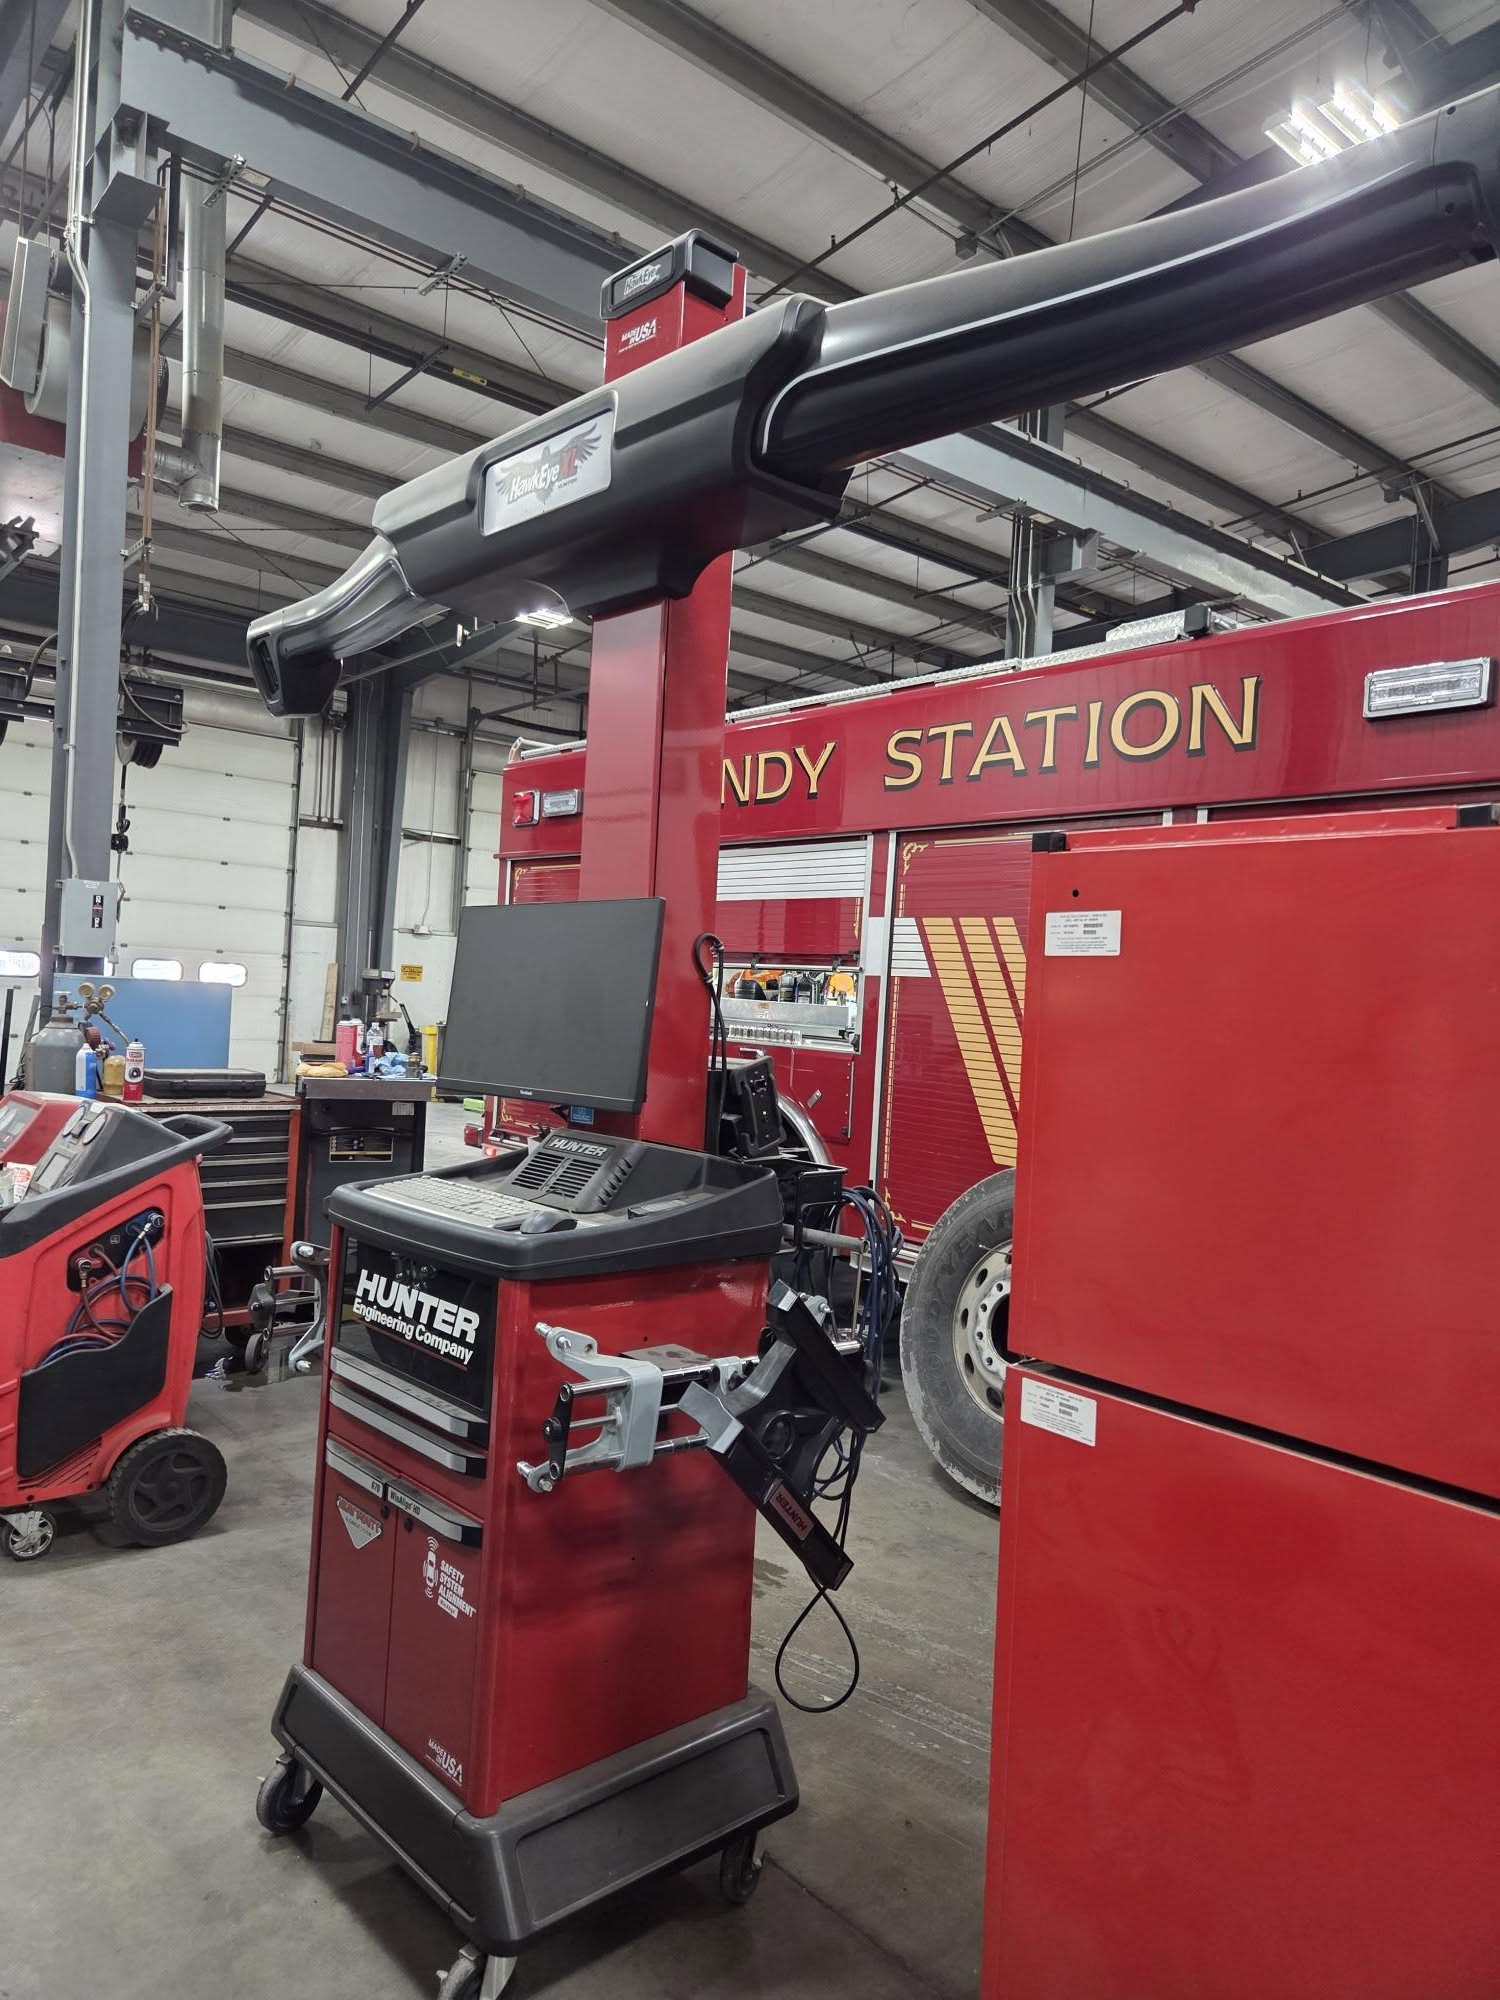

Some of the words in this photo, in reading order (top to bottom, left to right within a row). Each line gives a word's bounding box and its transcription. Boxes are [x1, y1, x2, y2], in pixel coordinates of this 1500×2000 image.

[635, 319, 656, 342] USA
[509, 464, 560, 501] HawkEye
[884, 674, 1262, 791] STATION
[549, 1138, 608, 1157] HUNTER
[356, 1269, 480, 1344] HUNTER
[353, 1298, 414, 1340] Engineering
[415, 1325, 473, 1365] Company
[371, 1481, 381, 1493] 670
[776, 1493, 808, 1531] HUNTER
[440, 1560, 465, 1584] SAFETY
[440, 1572, 464, 1598] SYSTEM
[438, 1584, 476, 1618] ALIGNMENT
[428, 1738, 445, 1757] MADE
[442, 1751, 463, 1783] USA
